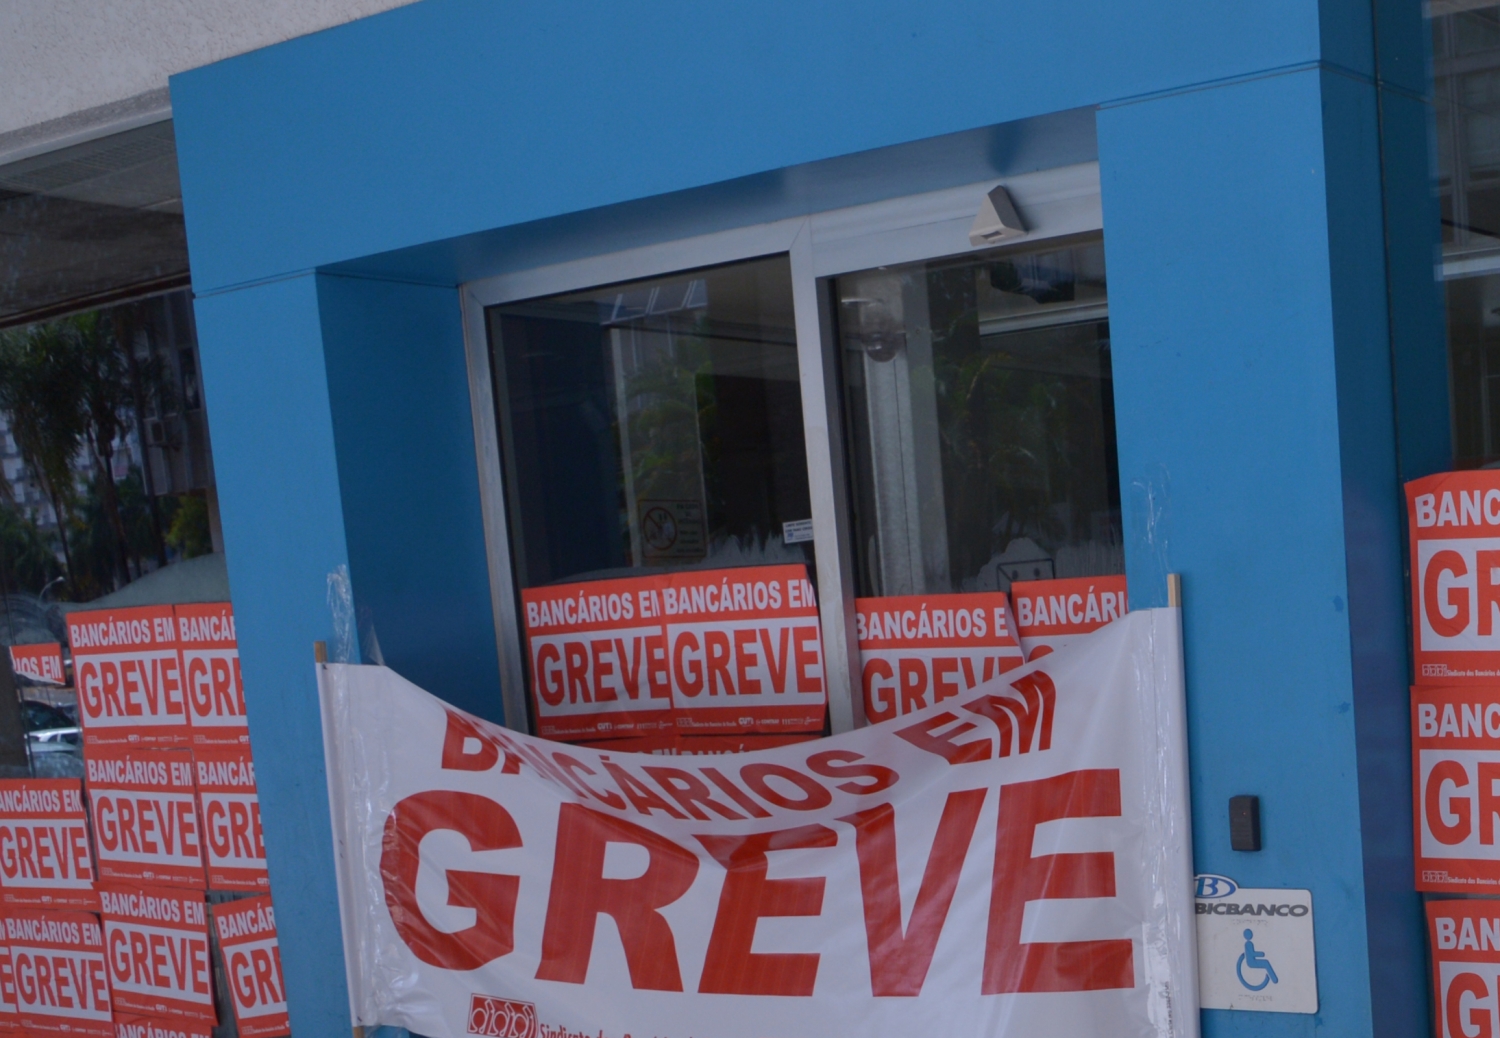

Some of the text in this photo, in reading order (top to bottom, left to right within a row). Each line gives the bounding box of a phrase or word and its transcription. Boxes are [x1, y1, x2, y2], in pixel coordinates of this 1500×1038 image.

[528, 593, 633, 627] BANCÁRIOS
[663, 579, 816, 614] BANCÁRIOS EM
[1017, 586, 1128, 627] BANCÁRI
[71, 616, 175, 647] BANCÁRIOS EM
[181, 610, 236, 642] BANCÁ
[857, 604, 986, 639] BANCÁRIOS
[537, 635, 669, 706] GREVE
[673, 626, 822, 697] GREVE
[80, 658, 183, 718] GREVE
[893, 670, 1057, 765] EM
[88, 756, 191, 785] BANCÁRIOS EM
[0, 786, 82, 812] ANCÁRIOS EM
[97, 796, 199, 857] GREVE
[0, 826, 91, 879] GREVE
[379, 769, 1135, 997] GREVE
[101, 892, 204, 924] BANCÁRIOS EM
[218, 904, 275, 939] BANCÁR
[1195, 902, 1308, 917] BICBANCO
[6, 919, 101, 945] BANCÁRIOS EM
[110, 928, 209, 994] GREVE
[16, 953, 109, 1012] GREVE
